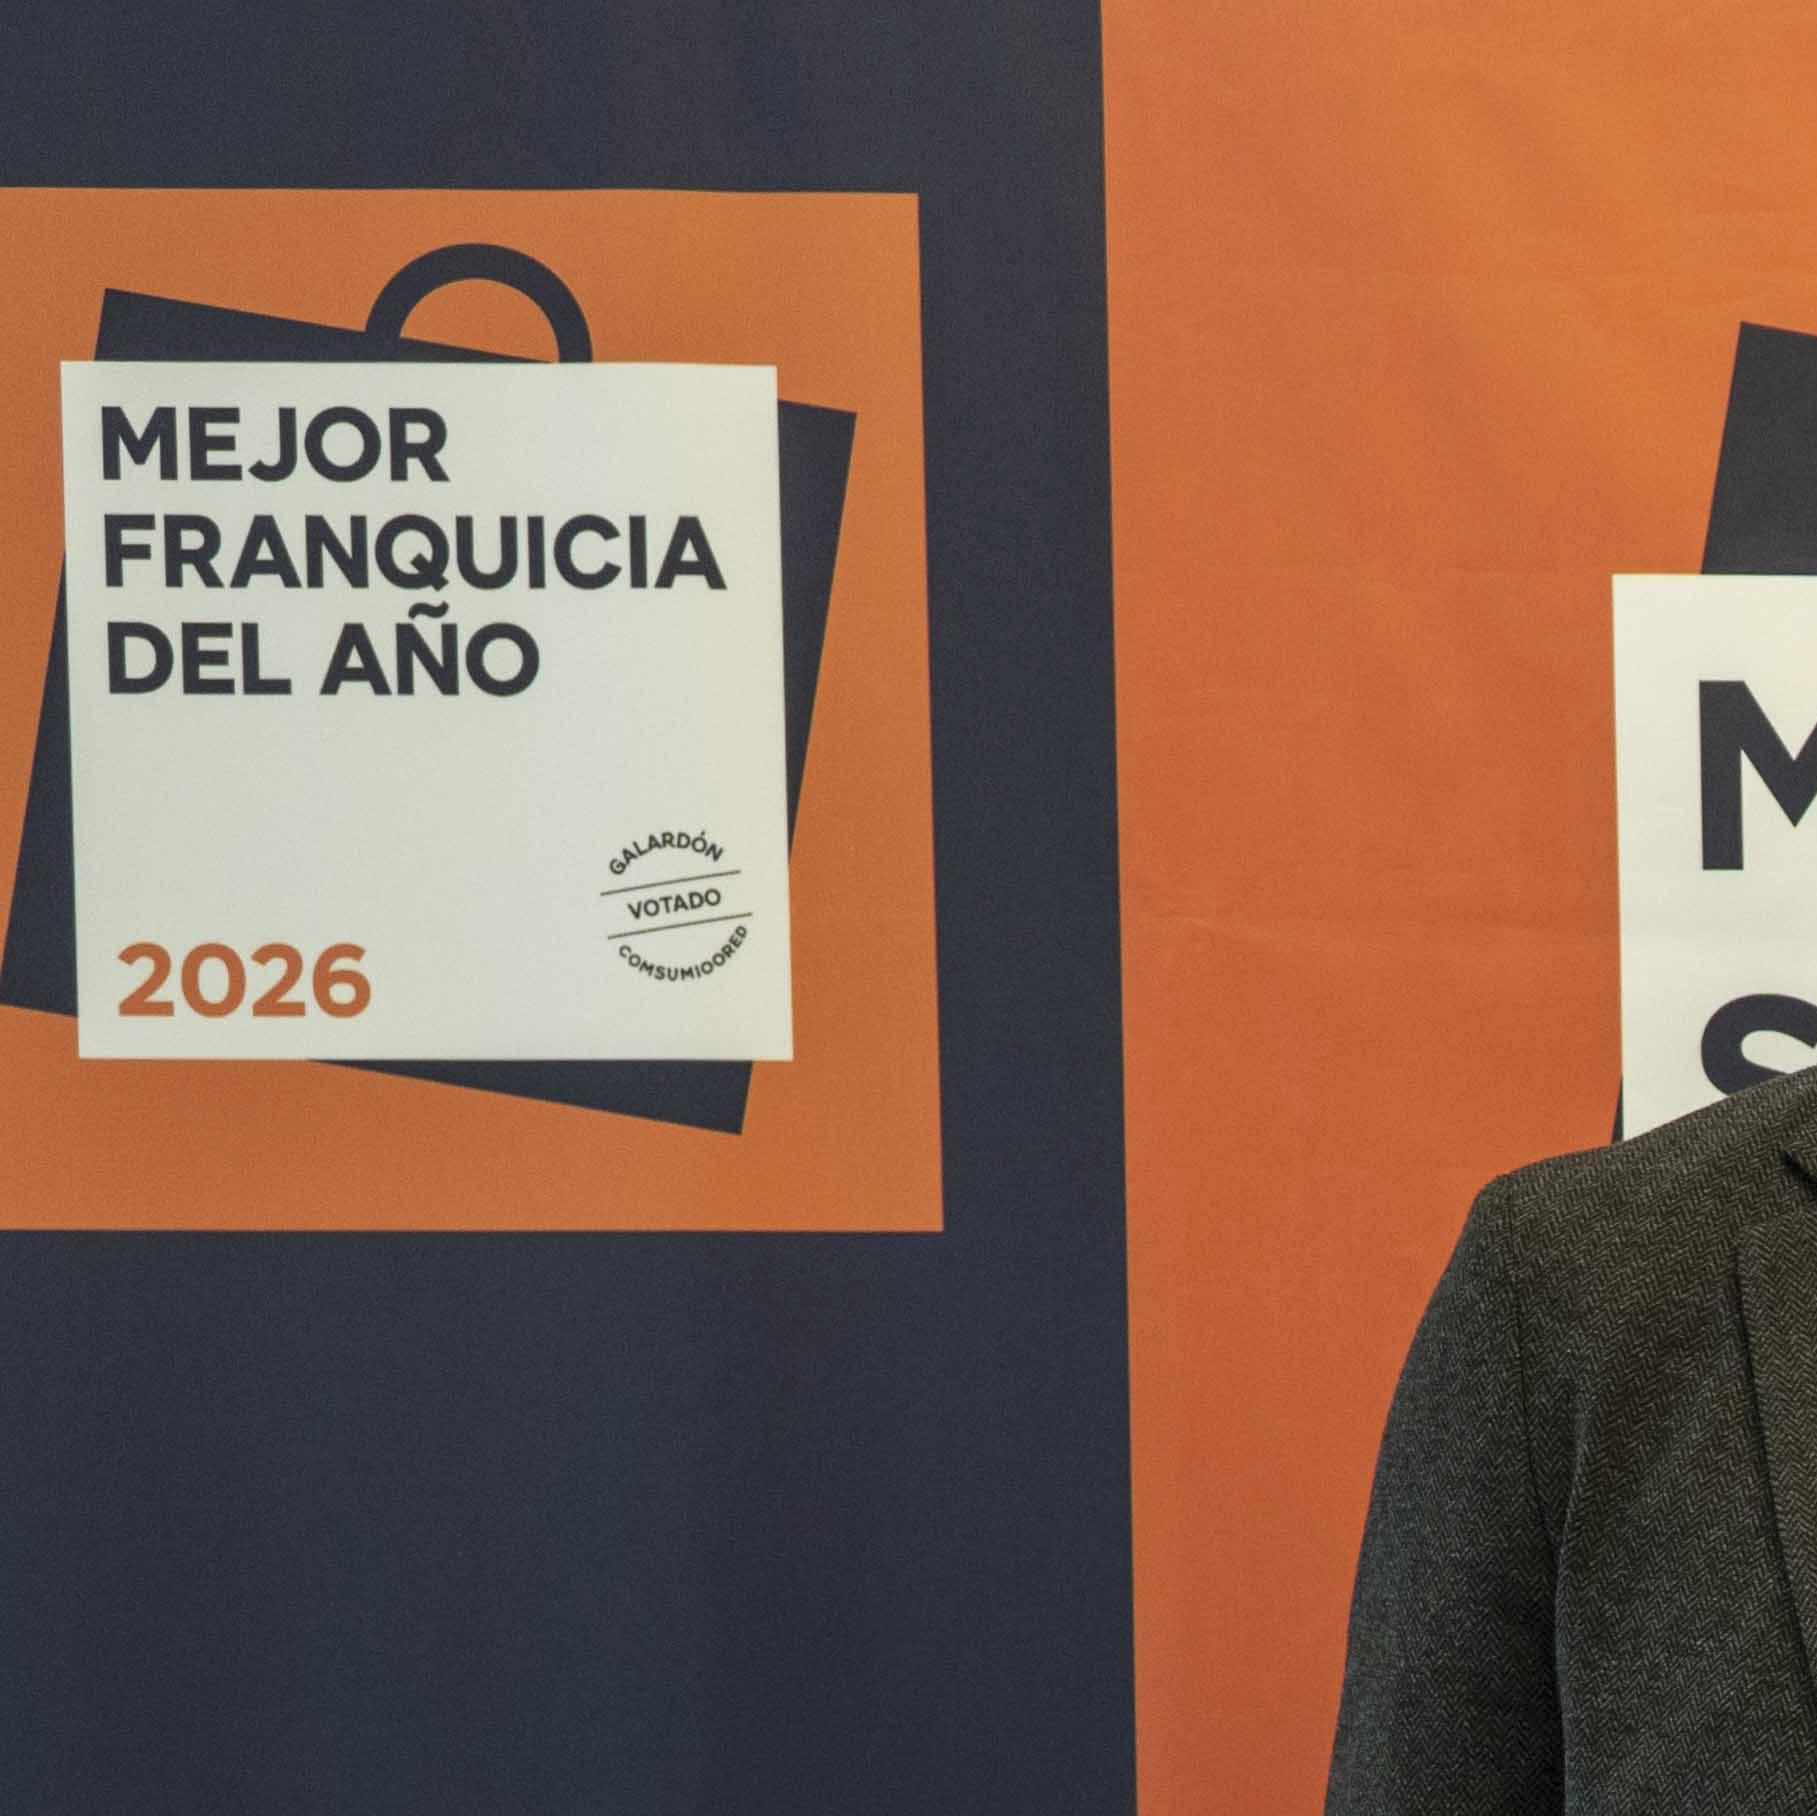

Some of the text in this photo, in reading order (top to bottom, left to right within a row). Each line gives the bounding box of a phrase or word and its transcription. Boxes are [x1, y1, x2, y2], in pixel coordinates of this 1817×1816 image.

[102, 406, 449, 482] MEJOR
[104, 514, 726, 591] FRANQUICIA
[108, 602, 539, 697] DEL AÑO
[609, 830, 724, 875] GALARDÓN
[627, 888, 722, 920] VOTADO
[118, 942, 371, 1018] 2026
